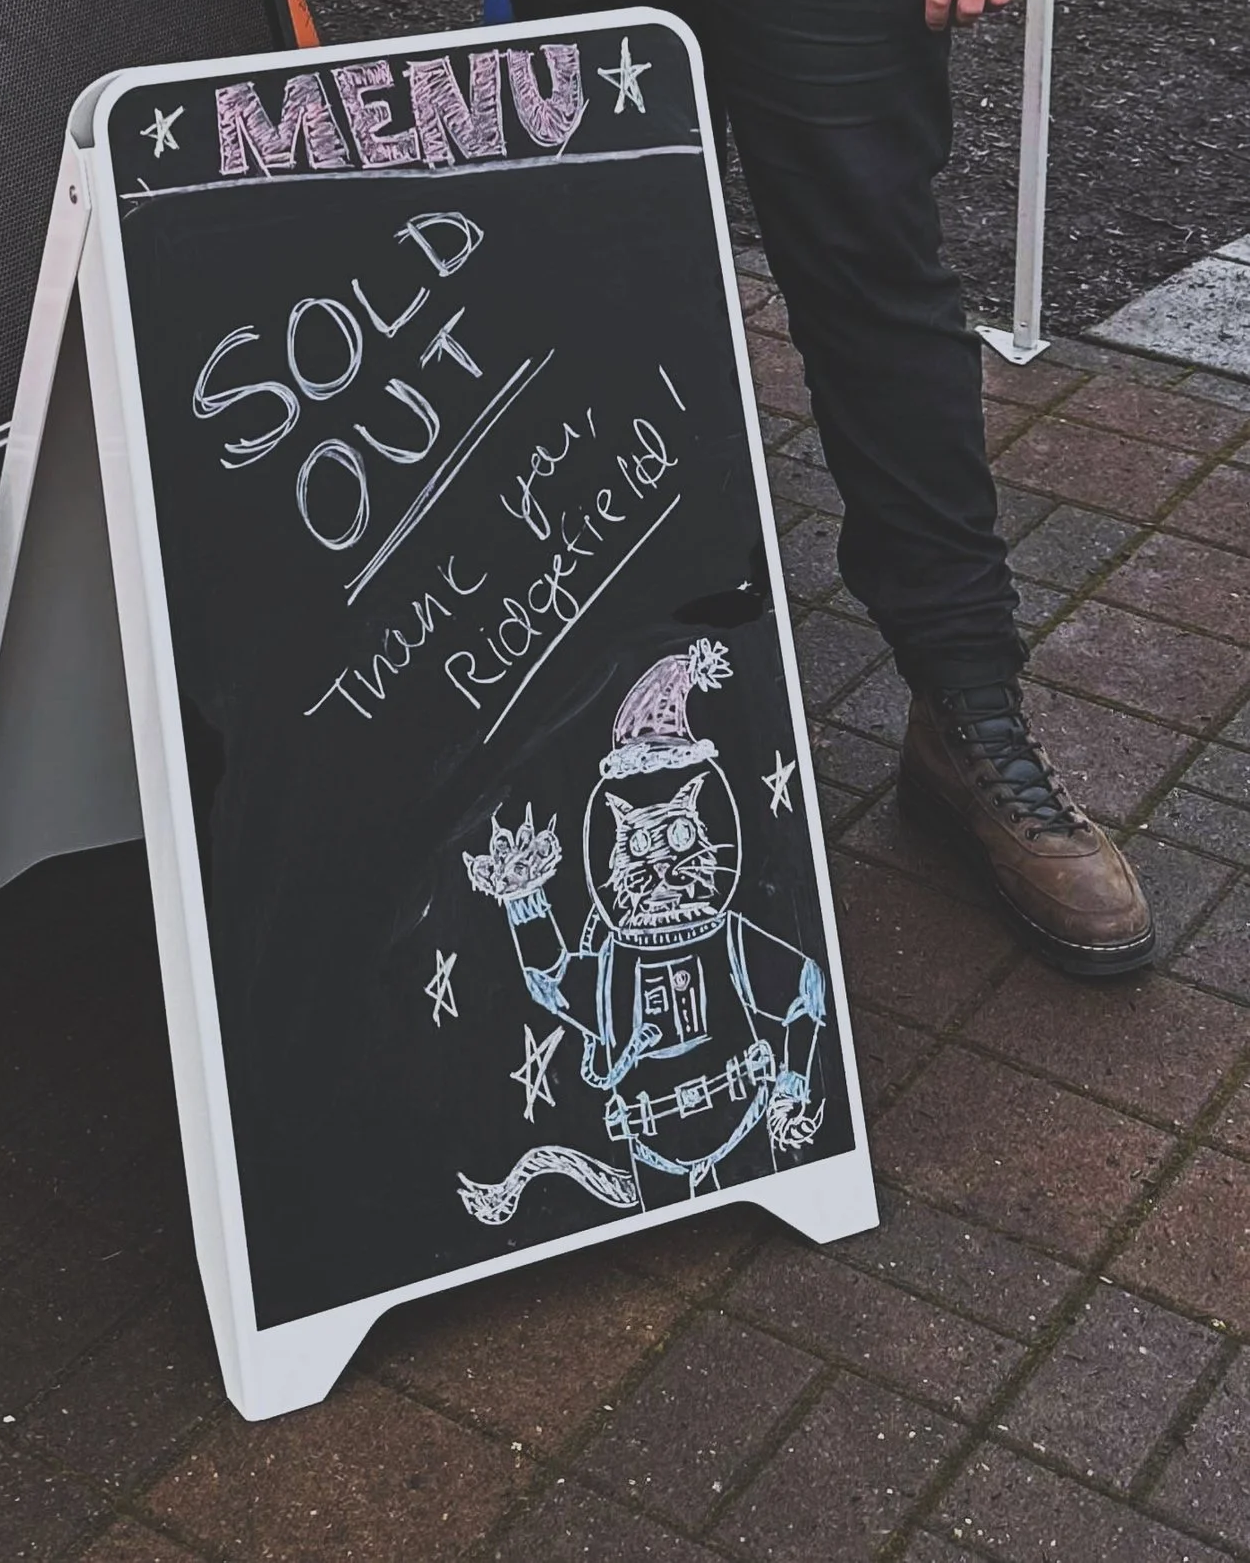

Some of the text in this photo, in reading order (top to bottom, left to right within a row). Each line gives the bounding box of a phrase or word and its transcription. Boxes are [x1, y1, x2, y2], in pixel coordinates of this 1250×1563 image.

[215, 42, 588, 178] MENU
[192, 211, 484, 469] SOLD
[296, 307, 482, 550] OUT
